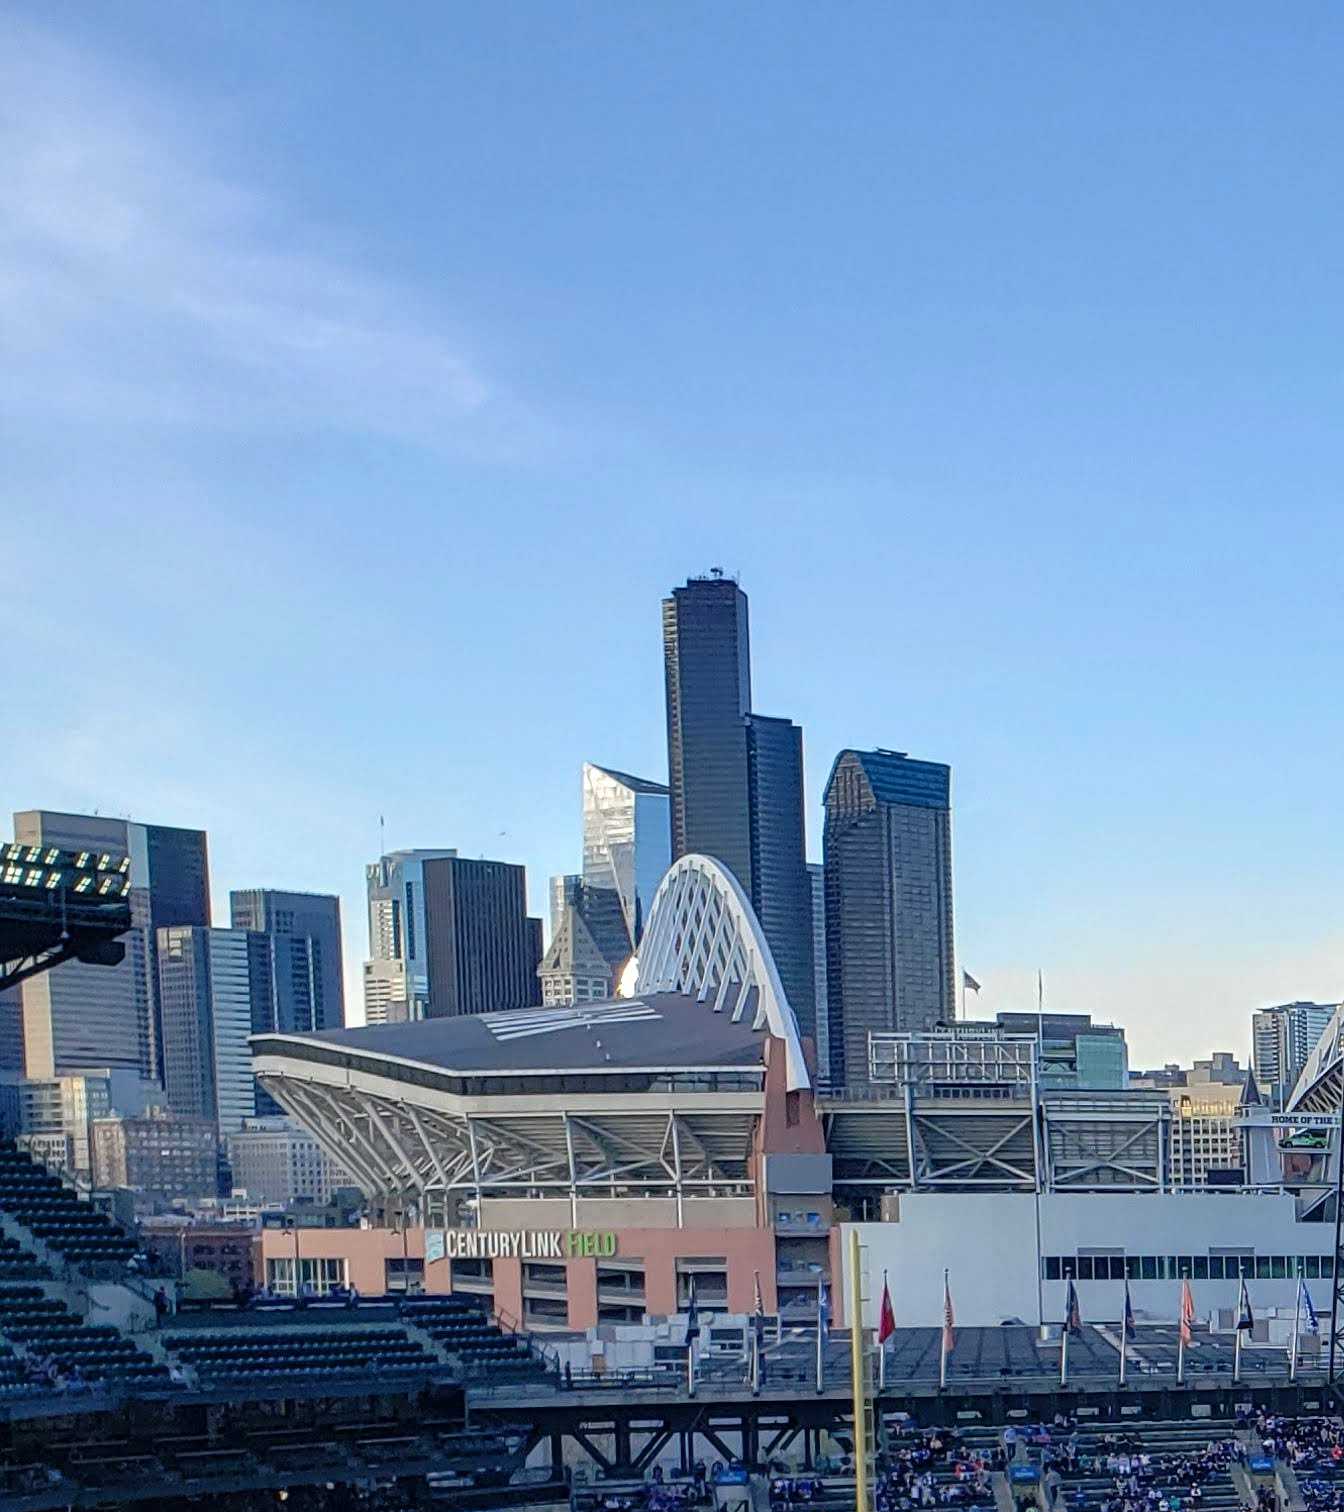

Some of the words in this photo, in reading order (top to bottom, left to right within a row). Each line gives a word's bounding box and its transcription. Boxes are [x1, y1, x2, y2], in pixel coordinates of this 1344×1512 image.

[1272, 1115, 1299, 1124] HOME
[1300, 1116, 1313, 1124] OF
[1314, 1116, 1332, 1125] THE
[567, 1231, 616, 1257] FIELD
